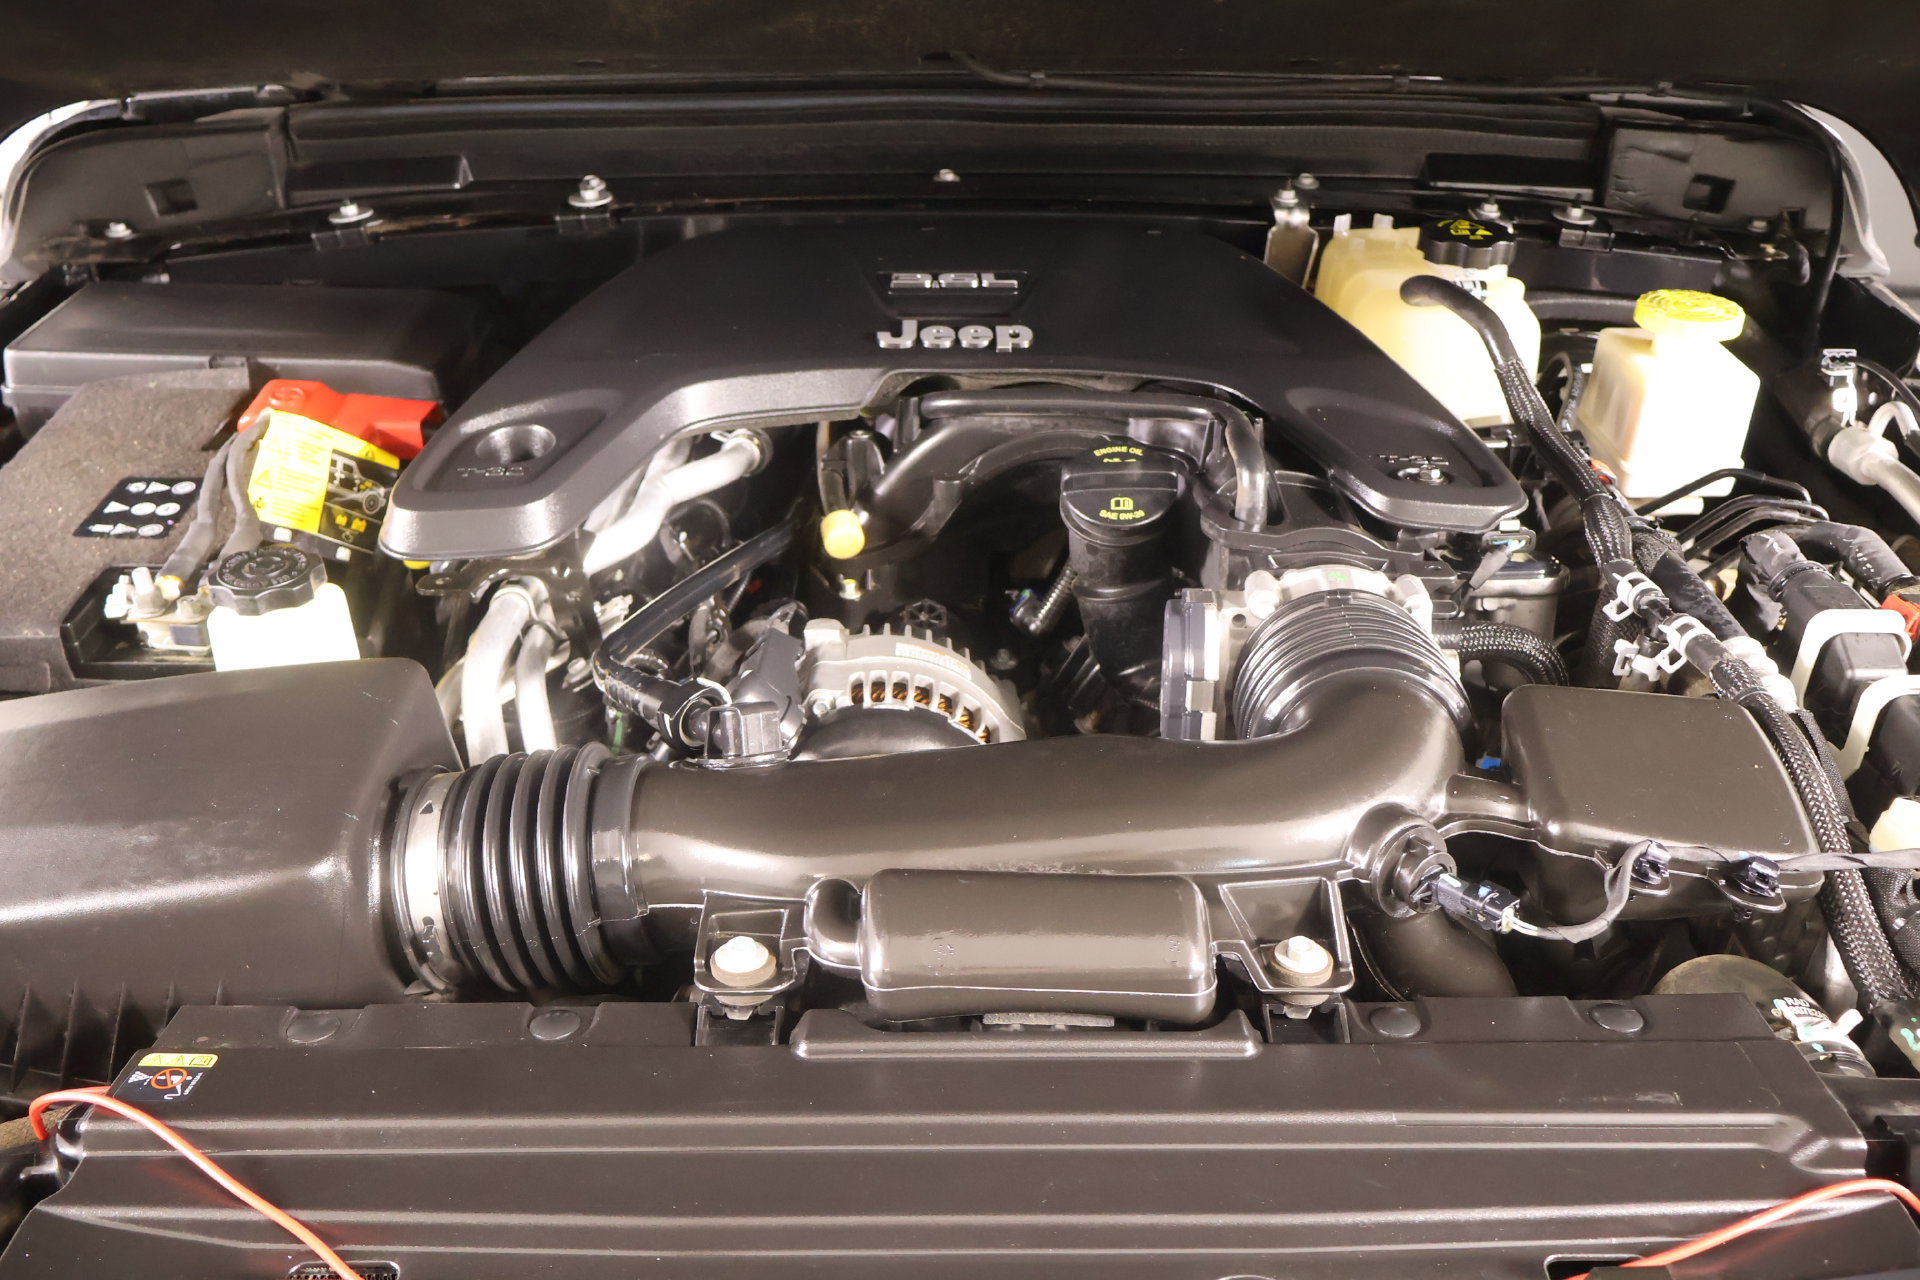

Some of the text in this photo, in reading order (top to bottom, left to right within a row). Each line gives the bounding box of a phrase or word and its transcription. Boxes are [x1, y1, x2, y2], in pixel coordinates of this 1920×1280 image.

[877, 320, 1033, 352] Jeep
[1093, 446, 1144, 457] ENGINE OIL
[1099, 509, 1145, 520] SAE 0W-20
[1784, 997, 1810, 1007] RAD
